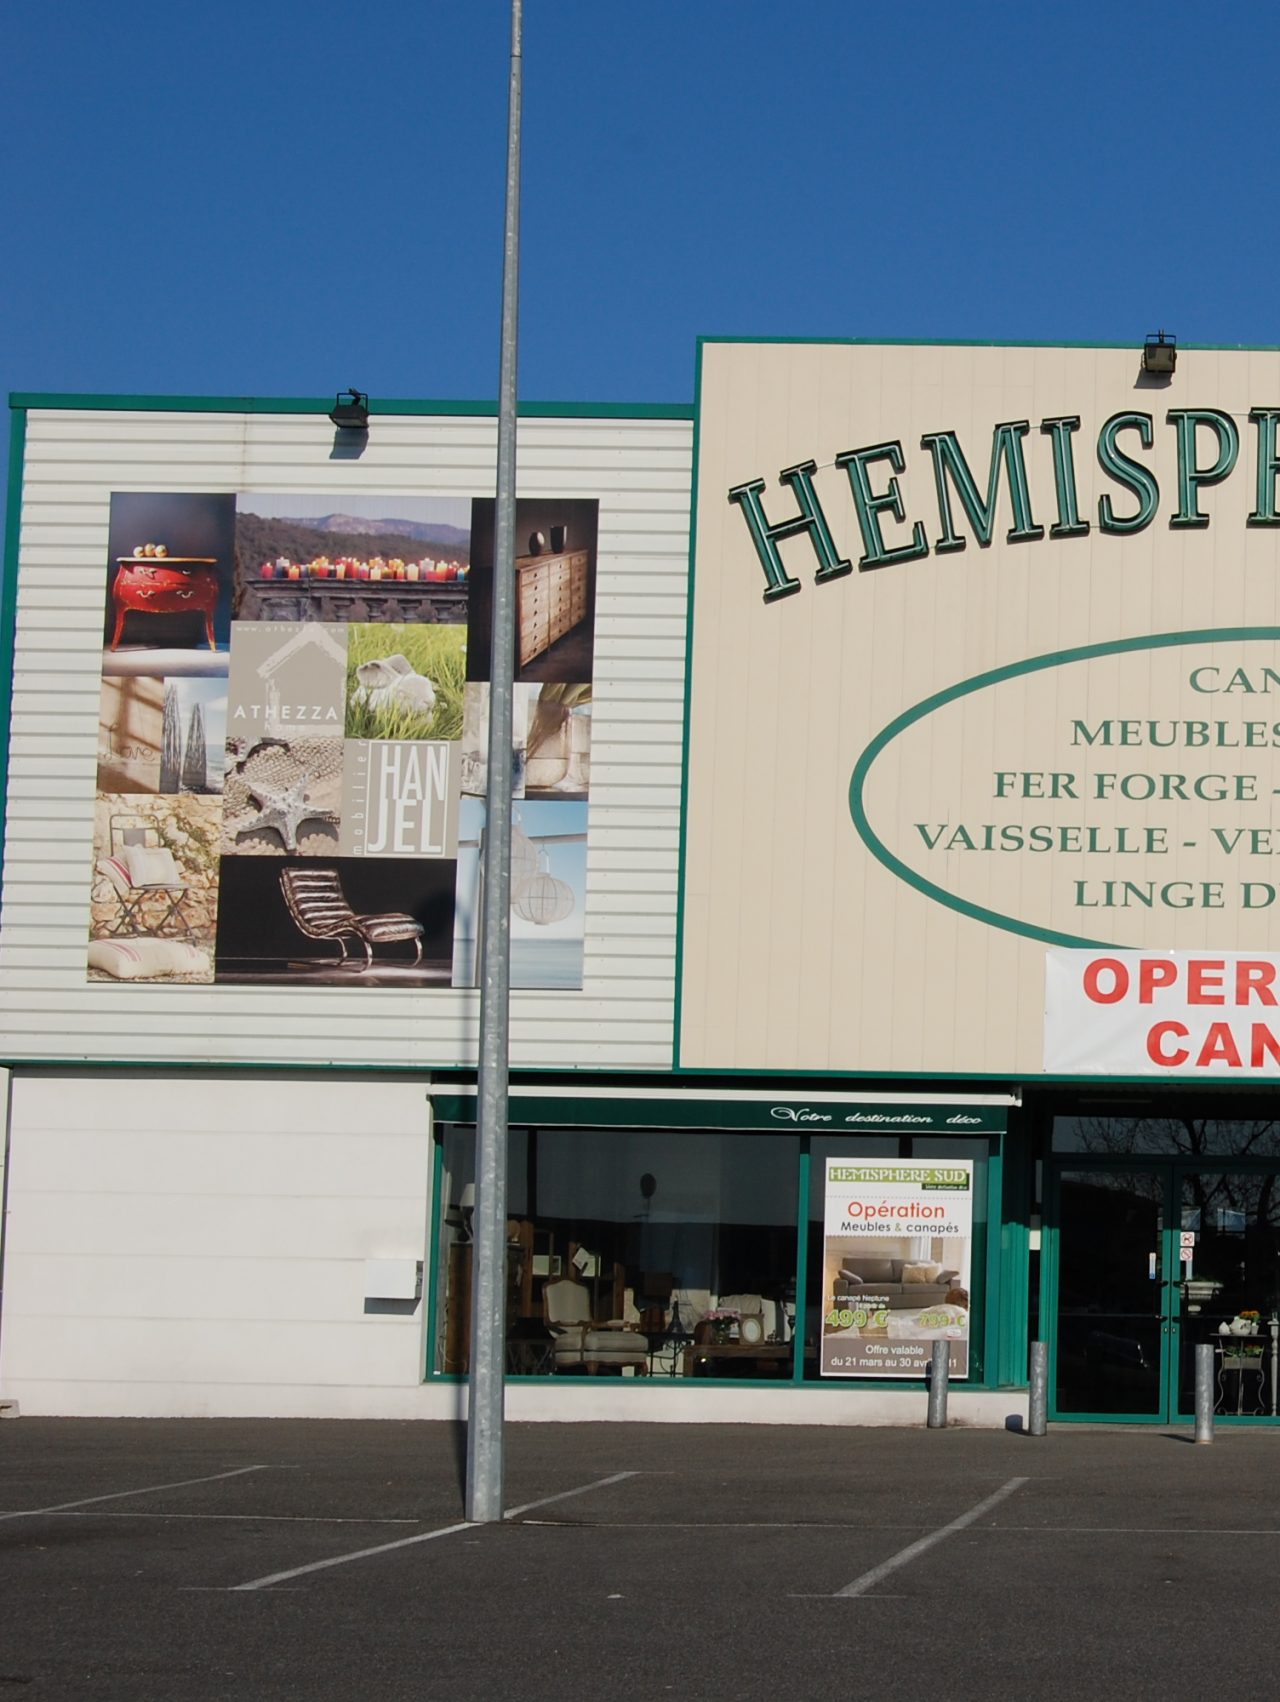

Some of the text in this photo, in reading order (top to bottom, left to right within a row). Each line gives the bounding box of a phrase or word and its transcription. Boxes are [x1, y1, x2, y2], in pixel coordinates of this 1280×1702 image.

[233, 704, 338, 720] ATHEZZA
[380, 744, 447, 801] HAN
[993, 772, 1079, 799] FER
[1093, 773, 1258, 801] FORGE
[351, 741, 367, 855] mobilier
[367, 798, 442, 853] JEL
[913, 824, 1169, 854] VAISSELLE
[1073, 880, 1225, 908] LINGE
[770, 1106, 982, 1125] Votre destination déco
[830, 1168, 966, 1182] HEMISPHERE SUD
[847, 1200, 945, 1220] Opération
[840, 1221, 892, 1232] Meubles
[906, 1222, 959, 1235] canapés
[825, 1309, 868, 1328] 499
[865, 1344, 924, 1355] Offre valable
[831, 1357, 843, 1366] du
[845, 1357, 857, 1366] 21
[859, 1359, 883, 1367] mars
[885, 1359, 897, 1367] au
[899, 1358, 911, 1367] 30
